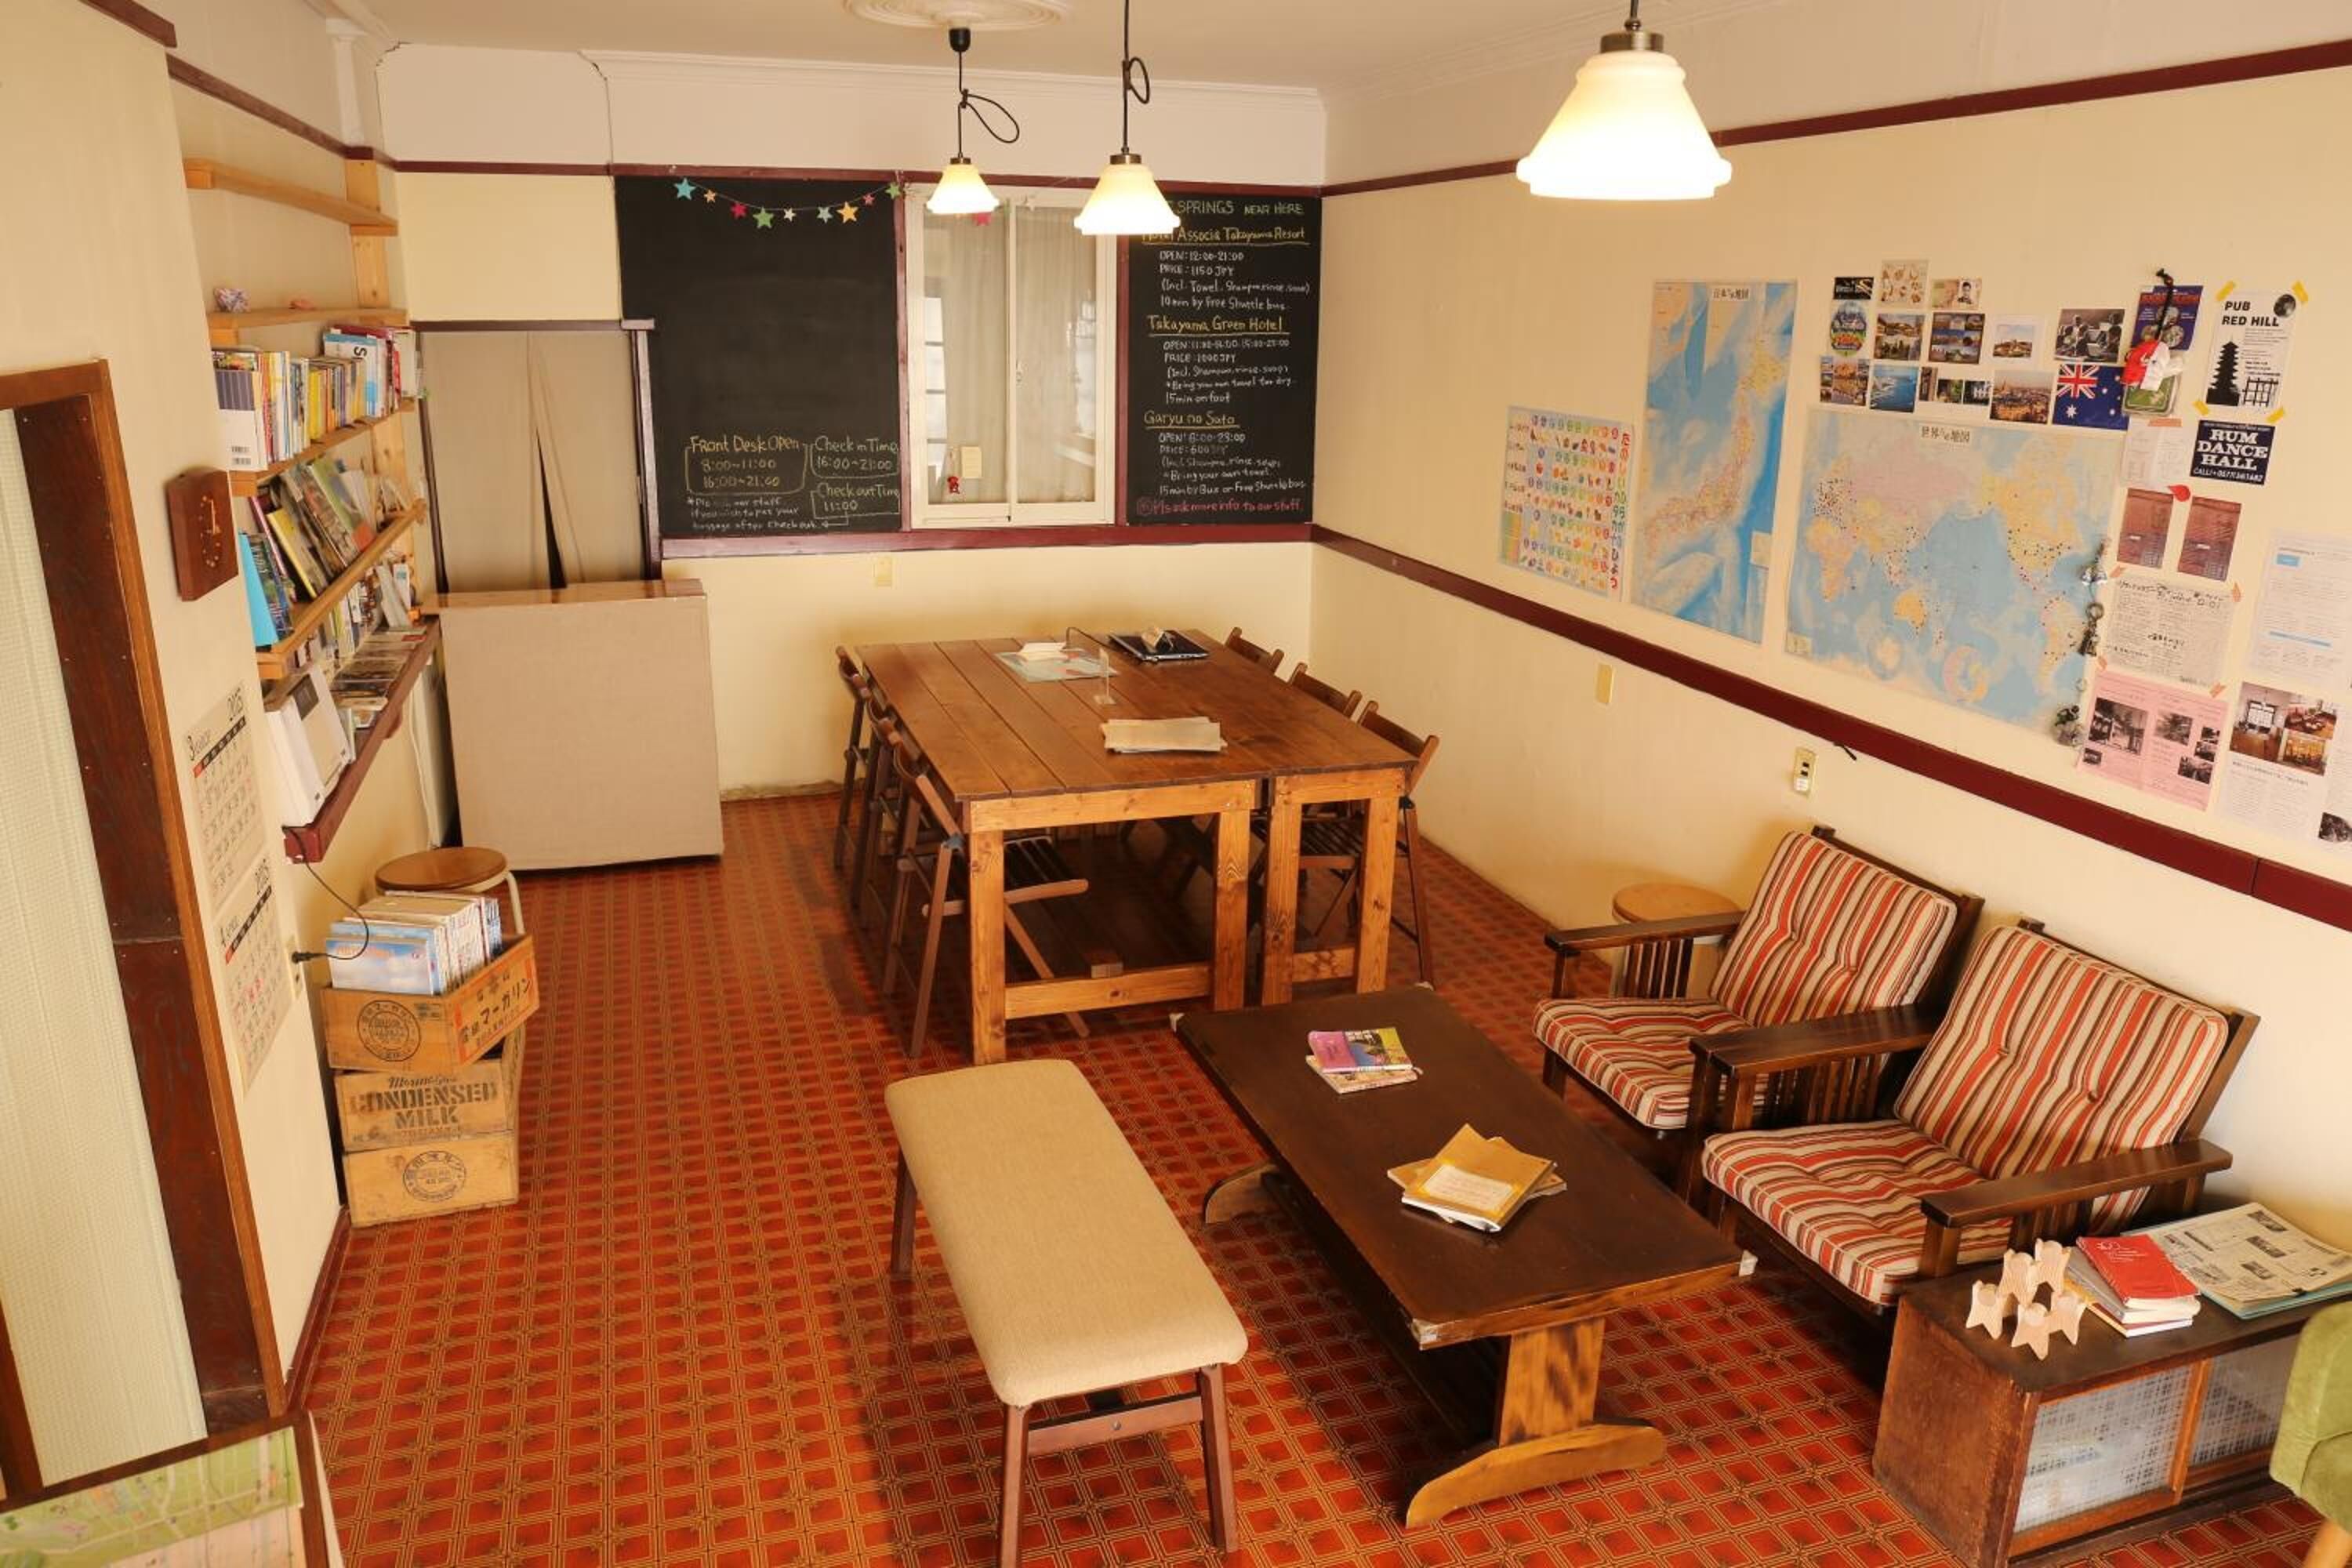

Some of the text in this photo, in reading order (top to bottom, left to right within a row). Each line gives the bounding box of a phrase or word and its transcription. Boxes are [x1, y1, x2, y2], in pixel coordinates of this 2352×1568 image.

[1177, 200, 1236, 215] SPRINGS
[1244, 203, 1270, 215] NEAR
[1274, 202, 1305, 215] HERE
[1274, 227, 1305, 239] Resort
[2224, 301, 2251, 311] PUB
[1146, 314, 1283, 333] Takayama Green Hotel
[2222, 316, 2280, 328] RED HILL
[1144, 410, 1236, 427] Garyu no Sato
[733, 434, 768, 454] Desk
[815, 435, 854, 452] Check
[866, 437, 898, 456] Time
[2209, 429, 2259, 445] RUM
[2197, 440, 2269, 459] DANCE
[2201, 454, 2258, 471] HALL
[816, 482, 855, 499] Check
[350, 1082, 498, 1113] CONDENSED
[395, 1105, 460, 1130] MILK
